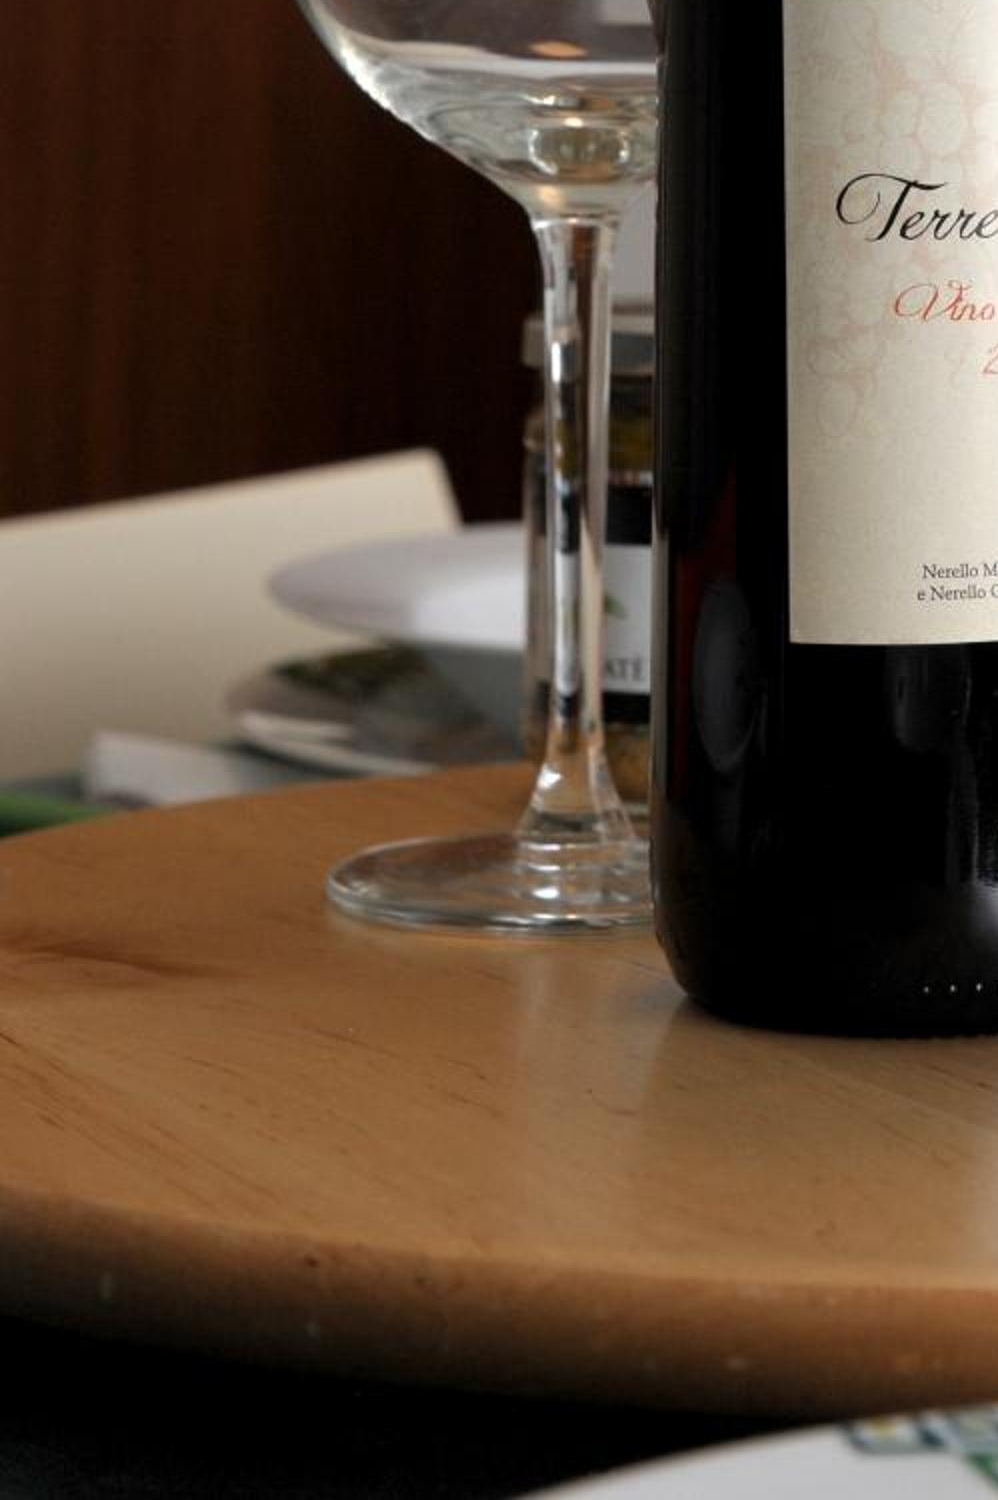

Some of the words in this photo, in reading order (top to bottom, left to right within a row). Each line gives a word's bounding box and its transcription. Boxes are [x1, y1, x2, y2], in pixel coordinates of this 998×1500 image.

[893, 279, 997, 322] Vino
[922, 563, 979, 580] Nerello
[916, 590, 926, 602] e
[931, 583, 987, 602] Nerello
